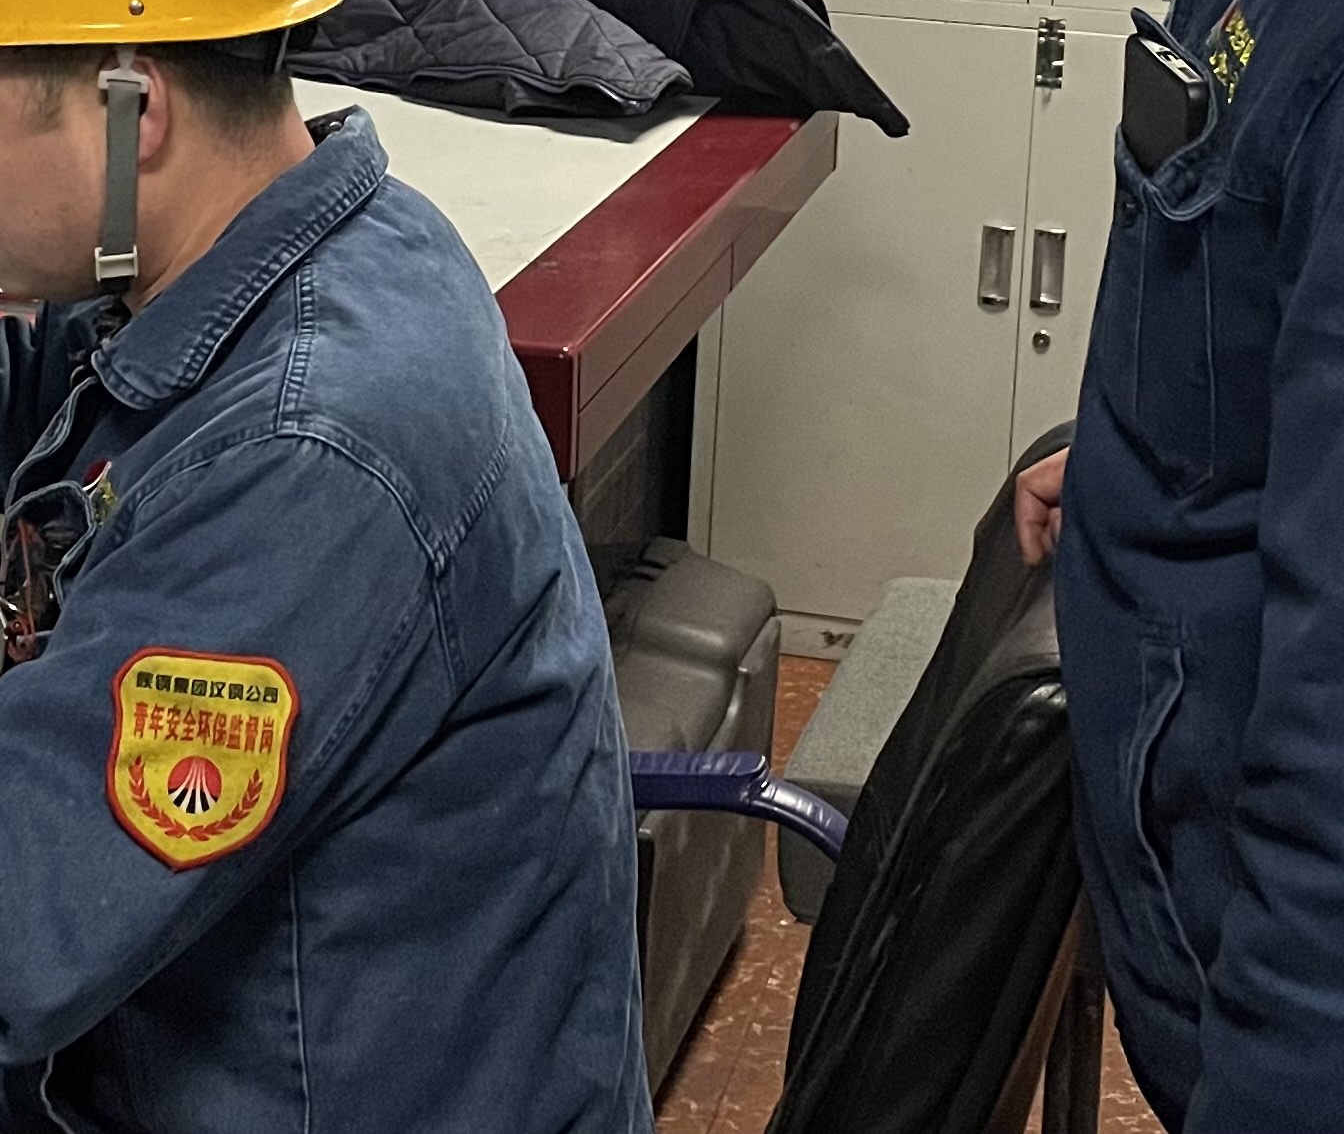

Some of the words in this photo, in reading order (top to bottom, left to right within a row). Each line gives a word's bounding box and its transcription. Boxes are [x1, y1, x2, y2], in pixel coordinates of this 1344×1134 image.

[136, 671, 279, 704] 陕钢集团汉钢公司
[133, 701, 274, 754] 青年安全环保监督岗
